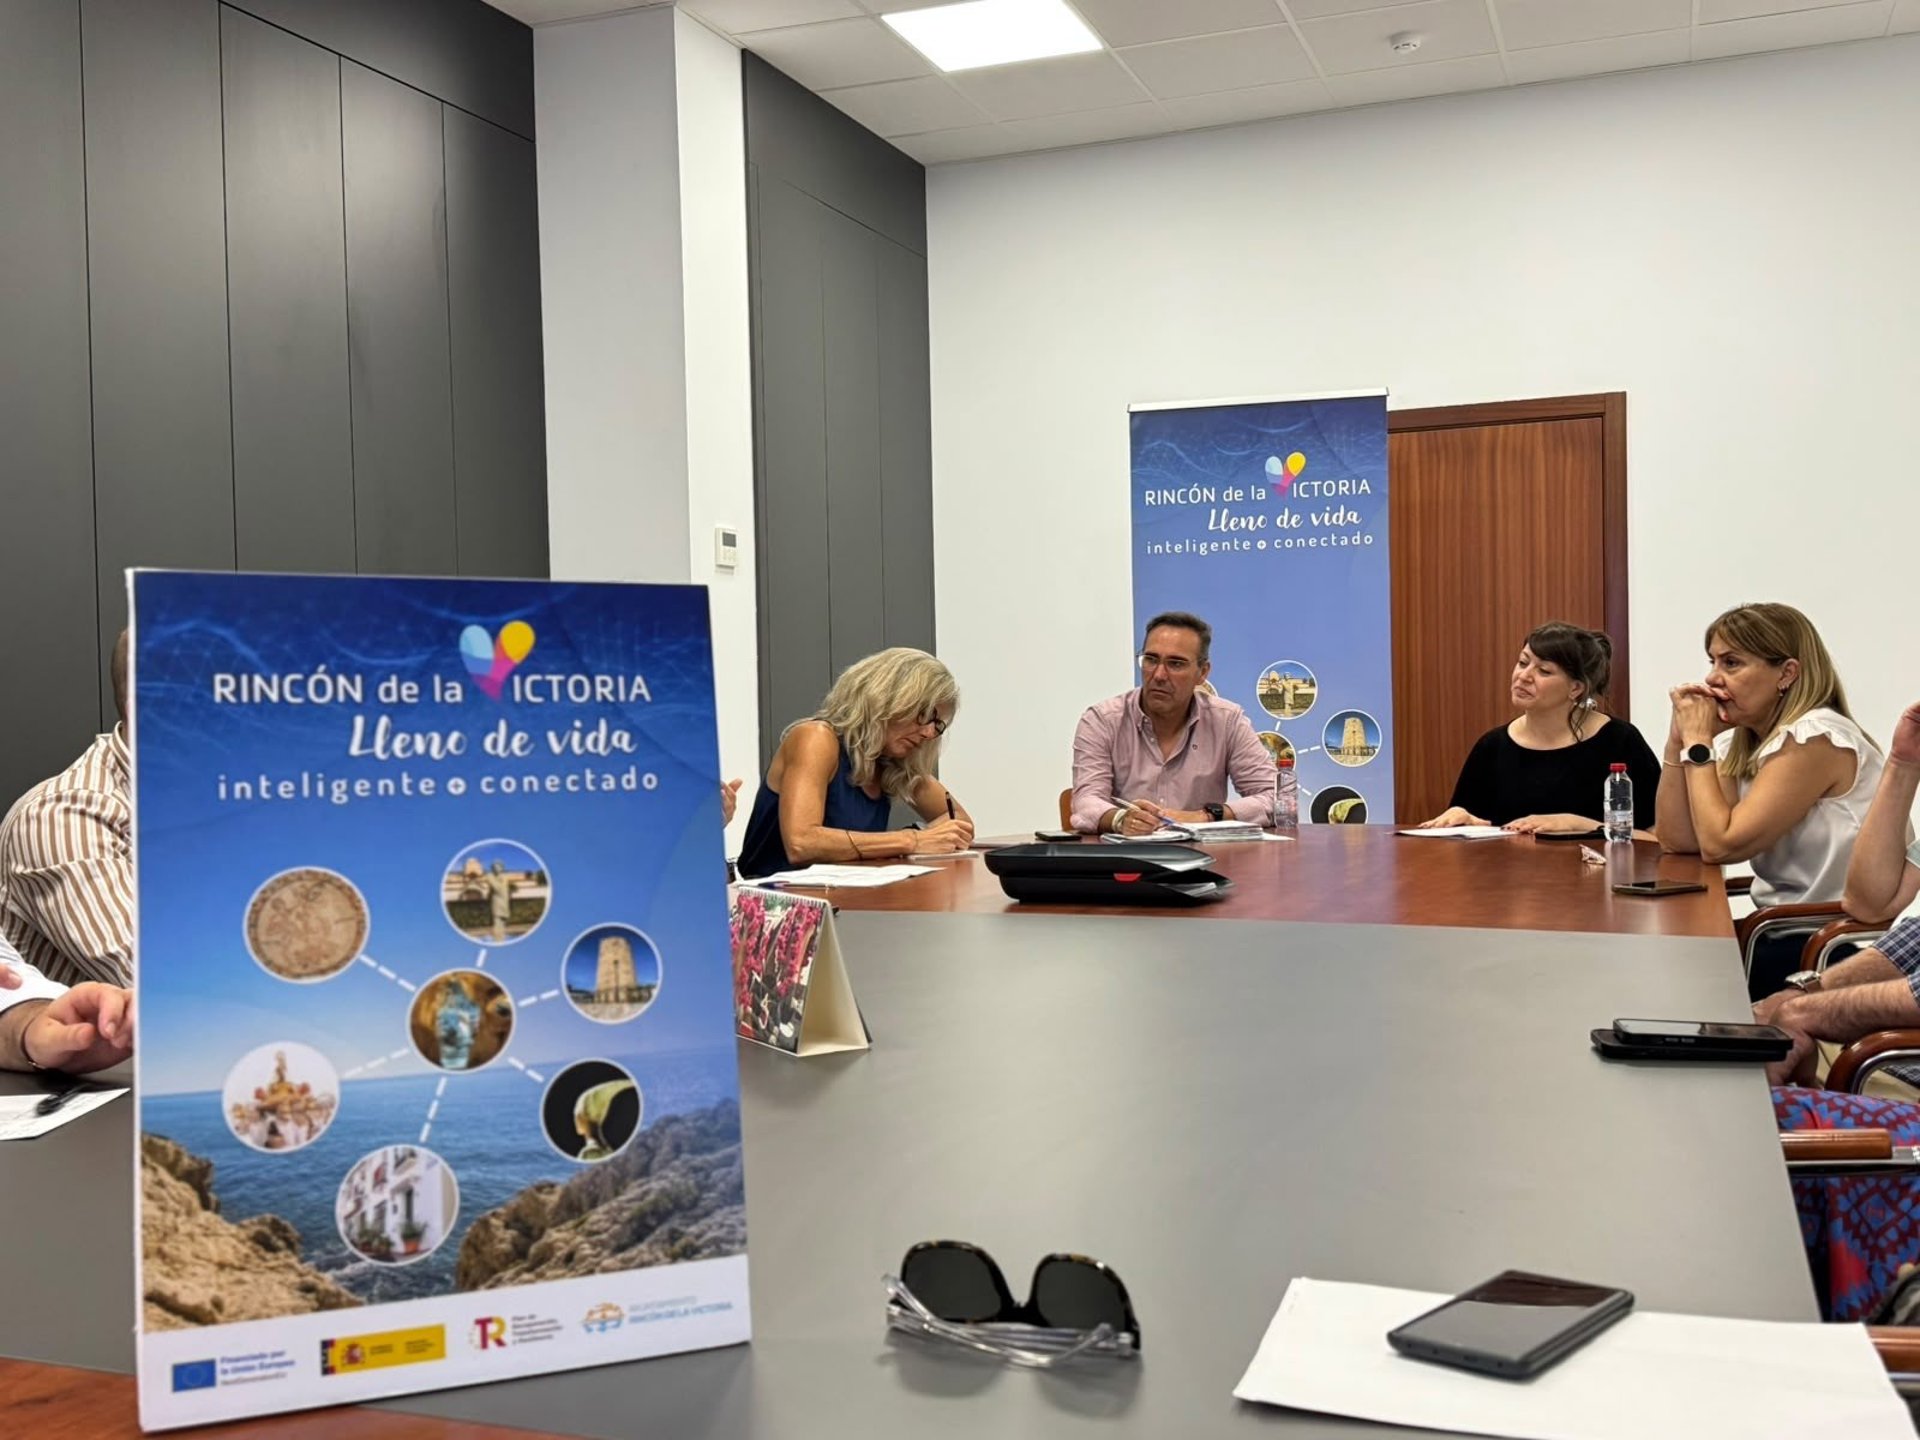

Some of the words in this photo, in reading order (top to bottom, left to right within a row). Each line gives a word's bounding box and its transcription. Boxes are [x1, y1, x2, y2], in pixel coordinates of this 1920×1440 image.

[1145, 483, 1216, 506] RINCÓN
[1223, 486, 1244, 502] de
[1251, 485, 1266, 501] la
[1208, 508, 1267, 532] Lleno
[1276, 507, 1304, 529] de
[1311, 504, 1362, 527] vida
[1147, 536, 1251, 556] inteligente
[1274, 531, 1374, 549] conectado
[213, 664, 364, 703] RINCÓN
[377, 674, 420, 703] de
[433, 674, 463, 703] la
[349, 714, 467, 760] Lleno
[483, 718, 534, 758] de
[547, 718, 637, 756] vida
[218, 771, 436, 804] inteligente
[480, 765, 659, 794] conectado
